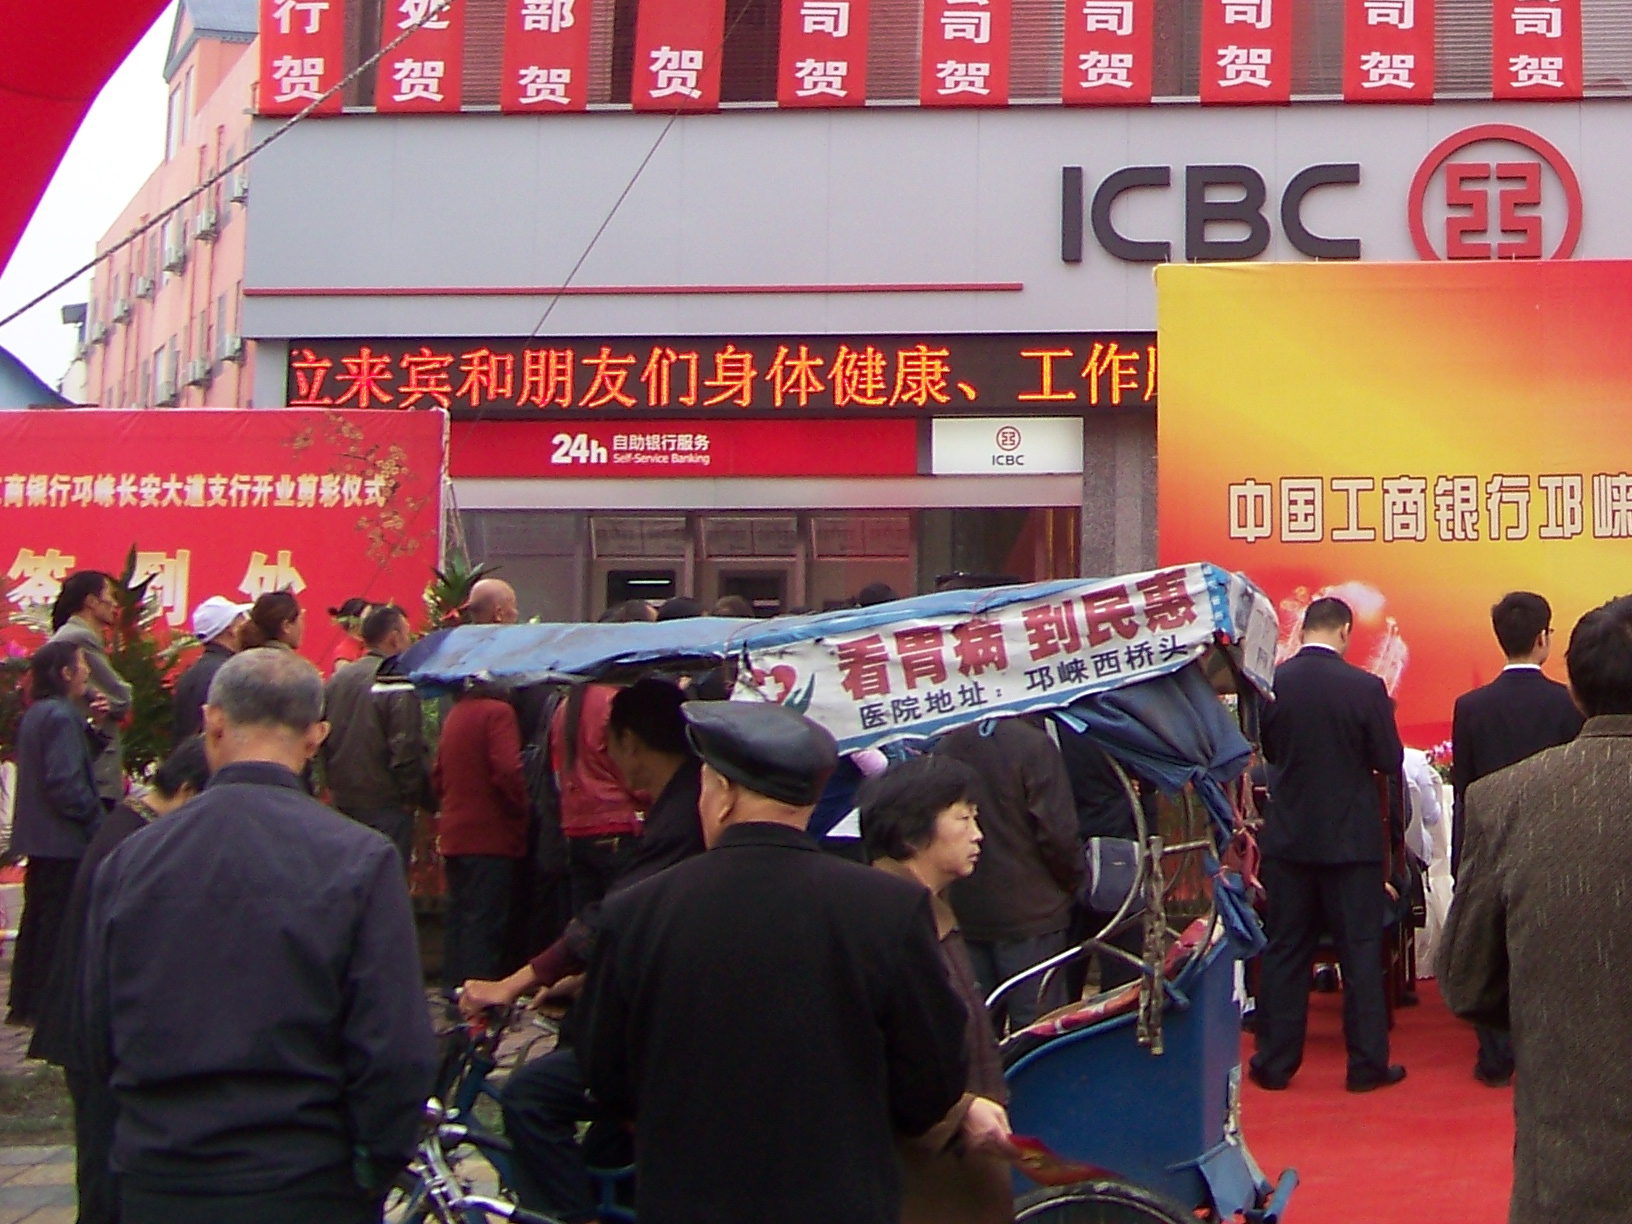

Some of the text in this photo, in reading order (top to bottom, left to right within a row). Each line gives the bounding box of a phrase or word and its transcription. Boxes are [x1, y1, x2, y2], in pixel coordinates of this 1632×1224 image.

[1061, 162, 1362, 264] ICBC
[551, 433, 710, 464] 24h 自助银行服务
[613, 453, 710, 466] Self-Service Banking
[991, 454, 1025, 466] ICBC
[0, 473, 389, 508] 商银行邛崃长安大道支行开业剪彩仪式
